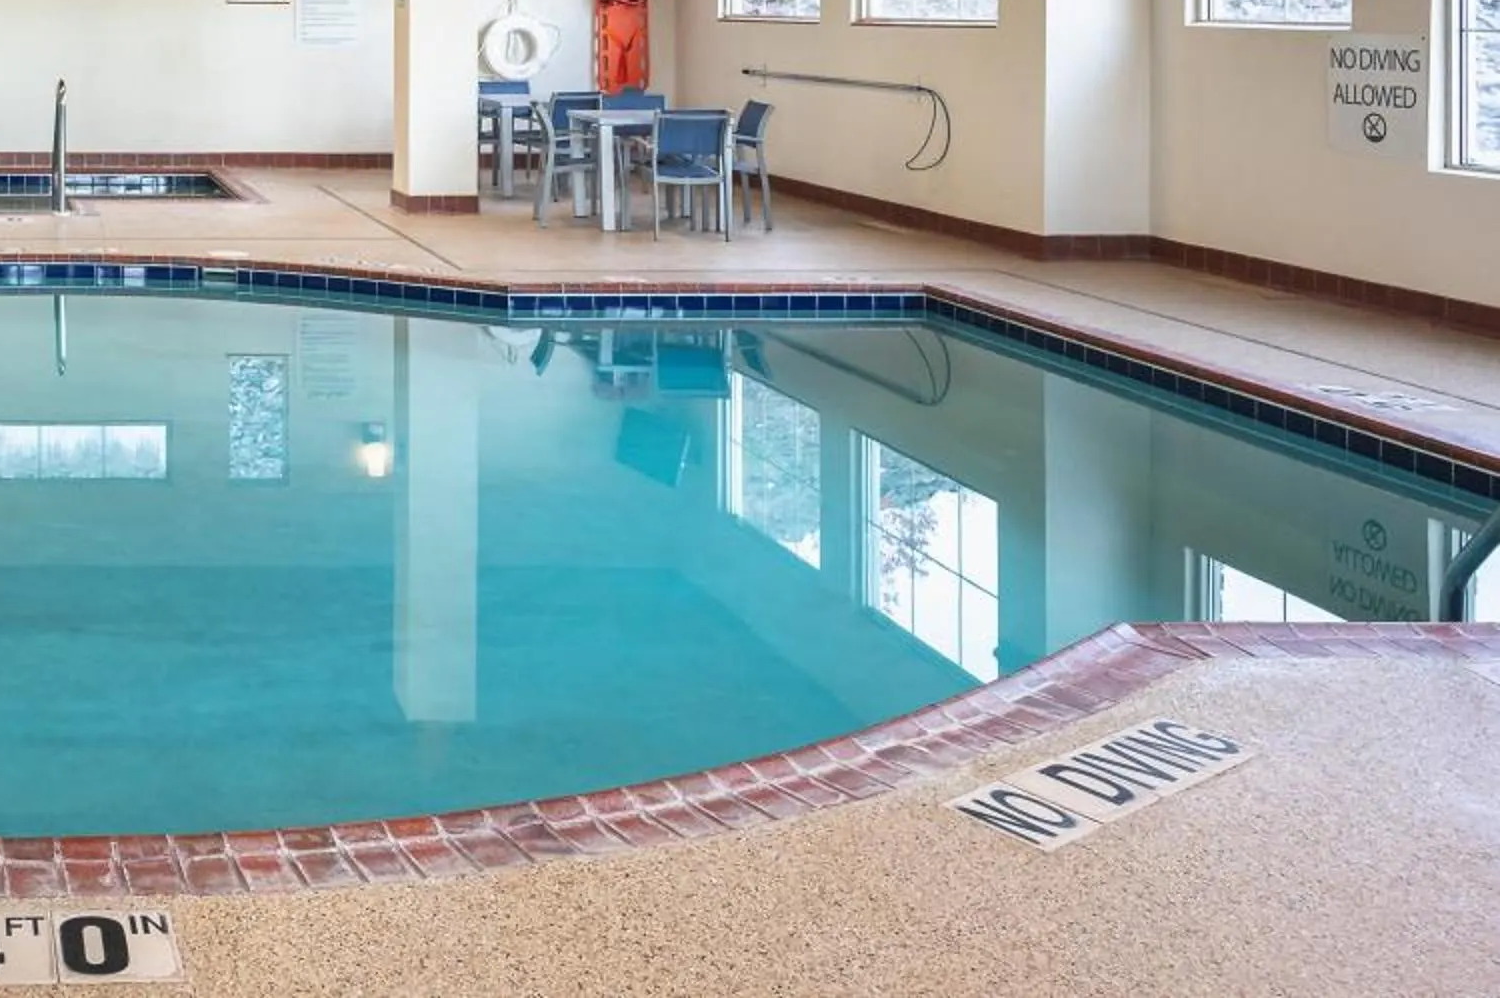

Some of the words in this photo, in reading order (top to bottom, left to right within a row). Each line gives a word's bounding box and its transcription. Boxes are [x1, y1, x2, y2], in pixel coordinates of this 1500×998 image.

[1330, 47, 1356, 69] NO
[1359, 48, 1421, 72] DIVING
[1333, 83, 1417, 109] ALLOWED
[957, 789, 1077, 845] NO
[1036, 721, 1240, 806] DIVING
[4, 916, 45, 937] FT
[128, 914, 169, 935] IN
